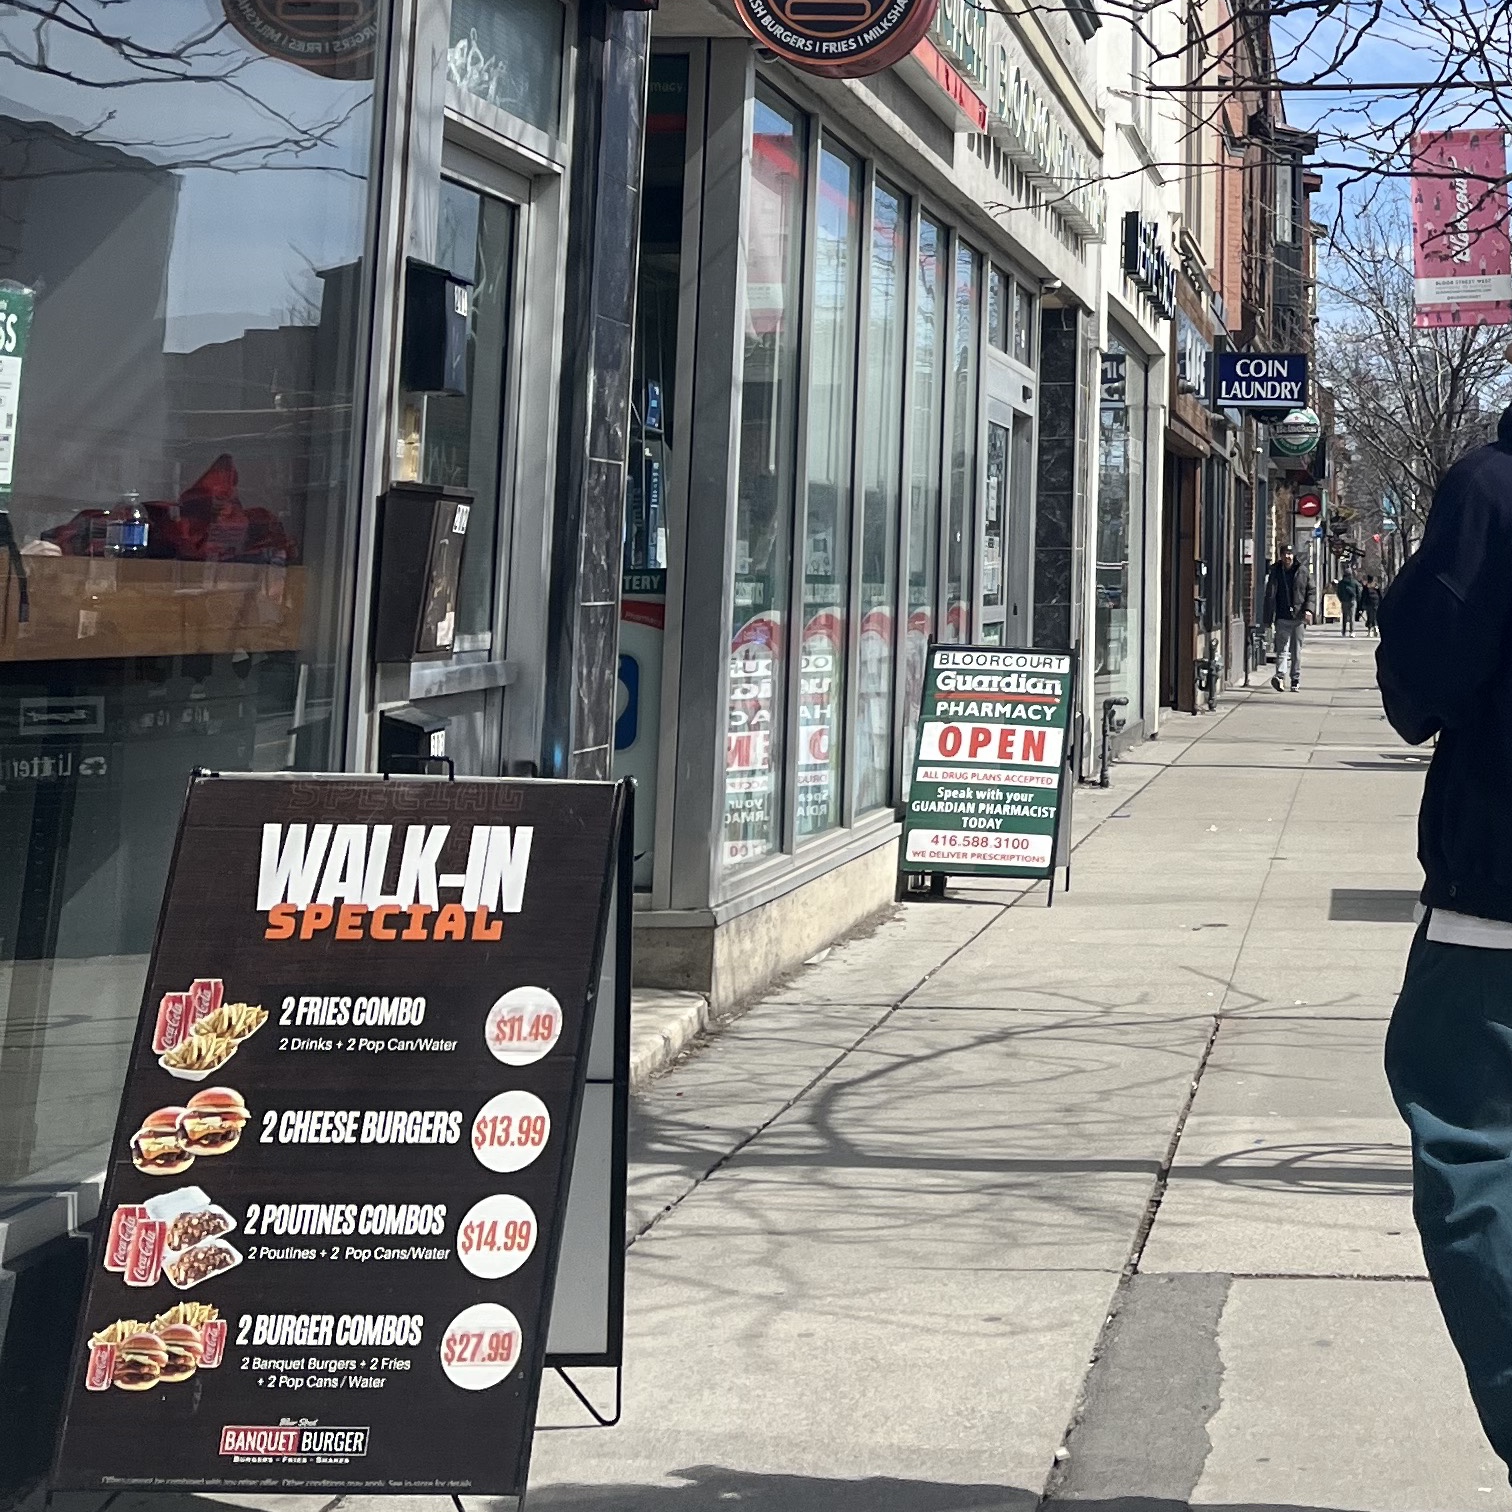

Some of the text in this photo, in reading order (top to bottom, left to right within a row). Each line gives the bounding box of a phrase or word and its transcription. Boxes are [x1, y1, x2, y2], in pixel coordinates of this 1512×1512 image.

[761, 13, 813, 52] BURGERS
[822, 37, 857, 54] FRIES
[1235, 359, 1288, 377] COIN
[1221, 381, 1301, 399] LAUNDRY
[939, 652, 1065, 669] BLOORCOURT
[936, 671, 1062, 695] Guardian
[936, 701, 1057, 721] PHARMACY
[938, 725, 1046, 762] OPEN
[922, 771, 1053, 785] ALL DRUG PLANS ACCEPTED
[936, 787, 1034, 803] Speak with your
[911, 800, 1056, 818] GUARDIAN PHARMACIST
[962, 817, 1003, 830] TODAY
[931, 834, 1029, 850] 416.588.3100
[912, 850, 1045, 863] WE DELIVER PRESCRIPTIONS
[256, 823, 534, 913] WALK-IN
[264, 903, 503, 941] SPECIAL
[279, 996, 426, 1026] 2 FRIES COMBO
[495, 1013, 553, 1043] $11.49
[278, 1038, 288, 1051] 2
[290, 1038, 333, 1052] Drinks
[346, 1038, 356, 1051] 2
[358, 1038, 385, 1055] Pop
[387, 1038, 457, 1053] Can/Water
[260, 1110, 463, 1144] 2 CHEESE BURGERS
[474, 1115, 546, 1150] $13.99
[244, 1204, 446, 1236] 2 POUTINES COMBOS
[461, 1221, 531, 1255] $14.99
[248, 1247, 257, 1260] 2
[260, 1246, 317, 1260] Poutines
[330, 1247, 340, 1260] 2
[345, 1247, 372, 1264] Pop
[373, 1246, 451, 1261] Cans/Water
[236, 1315, 423, 1346] 2 BURGER COMBOS
[443, 1330, 513, 1366] $27.99
[241, 1357, 250, 1370] 2
[252, 1357, 305, 1374] Banquet
[308, 1357, 357, 1374] Burgers
[370, 1357, 379, 1370] 2
[381, 1357, 411, 1371] Fries
[266, 1375, 276, 1388] 2
[278, 1375, 304, 1391] Pop
[305, 1375, 338, 1389] Cans
[347, 1375, 386, 1388] Water
[224, 1431, 364, 1454] BANQUET BURGER
